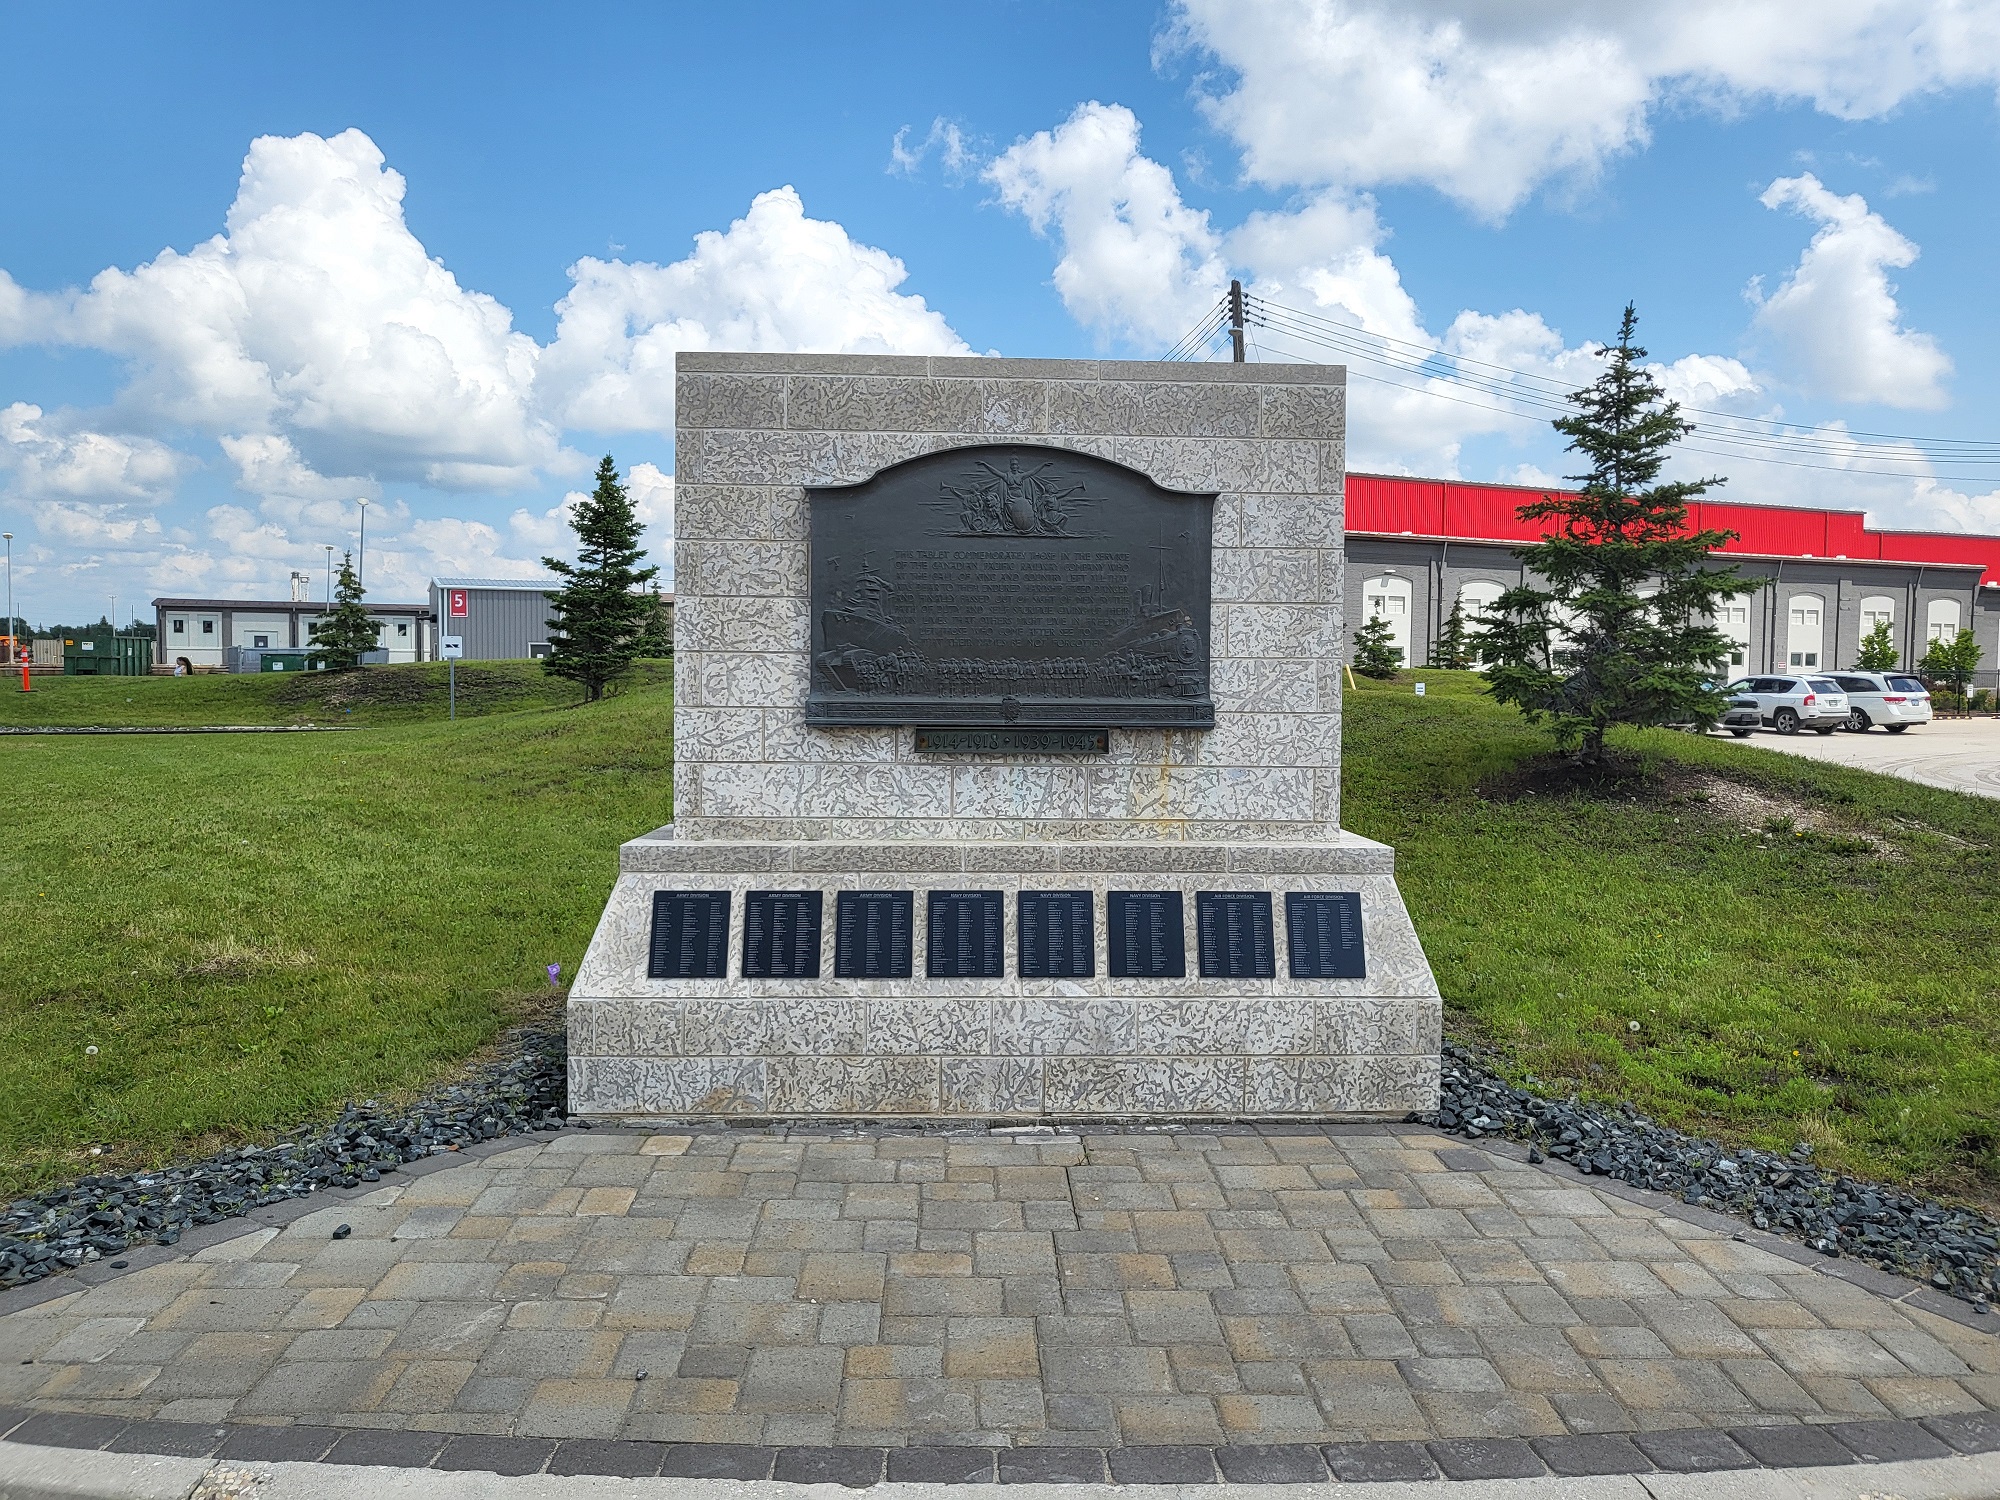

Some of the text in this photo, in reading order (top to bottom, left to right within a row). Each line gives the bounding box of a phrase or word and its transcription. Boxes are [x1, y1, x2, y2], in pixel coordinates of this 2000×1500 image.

[916, 550, 950, 559] TABLET
[1030, 551, 1056, 560] THOSE
[1060, 551, 1070, 560] IN
[1074, 551, 1090, 560] THE
[894, 561, 908, 570] OF
[910, 561, 928, 570] THE
[932, 561, 978, 570] CANADIAN
[1064, 562, 1104, 571] COMPANY
[1108, 562, 1130, 572] WHO
[910, 572, 928, 581] THE
[932, 573, 954, 581] CALL
[958, 573, 970, 581] OF
[1000, 573, 1019, 581] AND
[1068, 573, 1087, 582] LEFT
[940, 584, 954, 592] TO
[982, 584, 1021, 592] ENDURED
[454, 594, 463, 608] 5
[994, 594, 1013, 603] OUT
[1059, 595, 1073, 603] OF
[1114, 595, 1130, 604] THE
[921, 605, 933, 613] OF
[1072, 617, 1080, 625] IN
[1078, 628, 1091, 636] TO
[1028, 638, 1047, 647] NOT
[1052, 638, 1104, 647] FORGOTTEN
[927, 733, 1096, 750] 1914-1918 1939-1945
